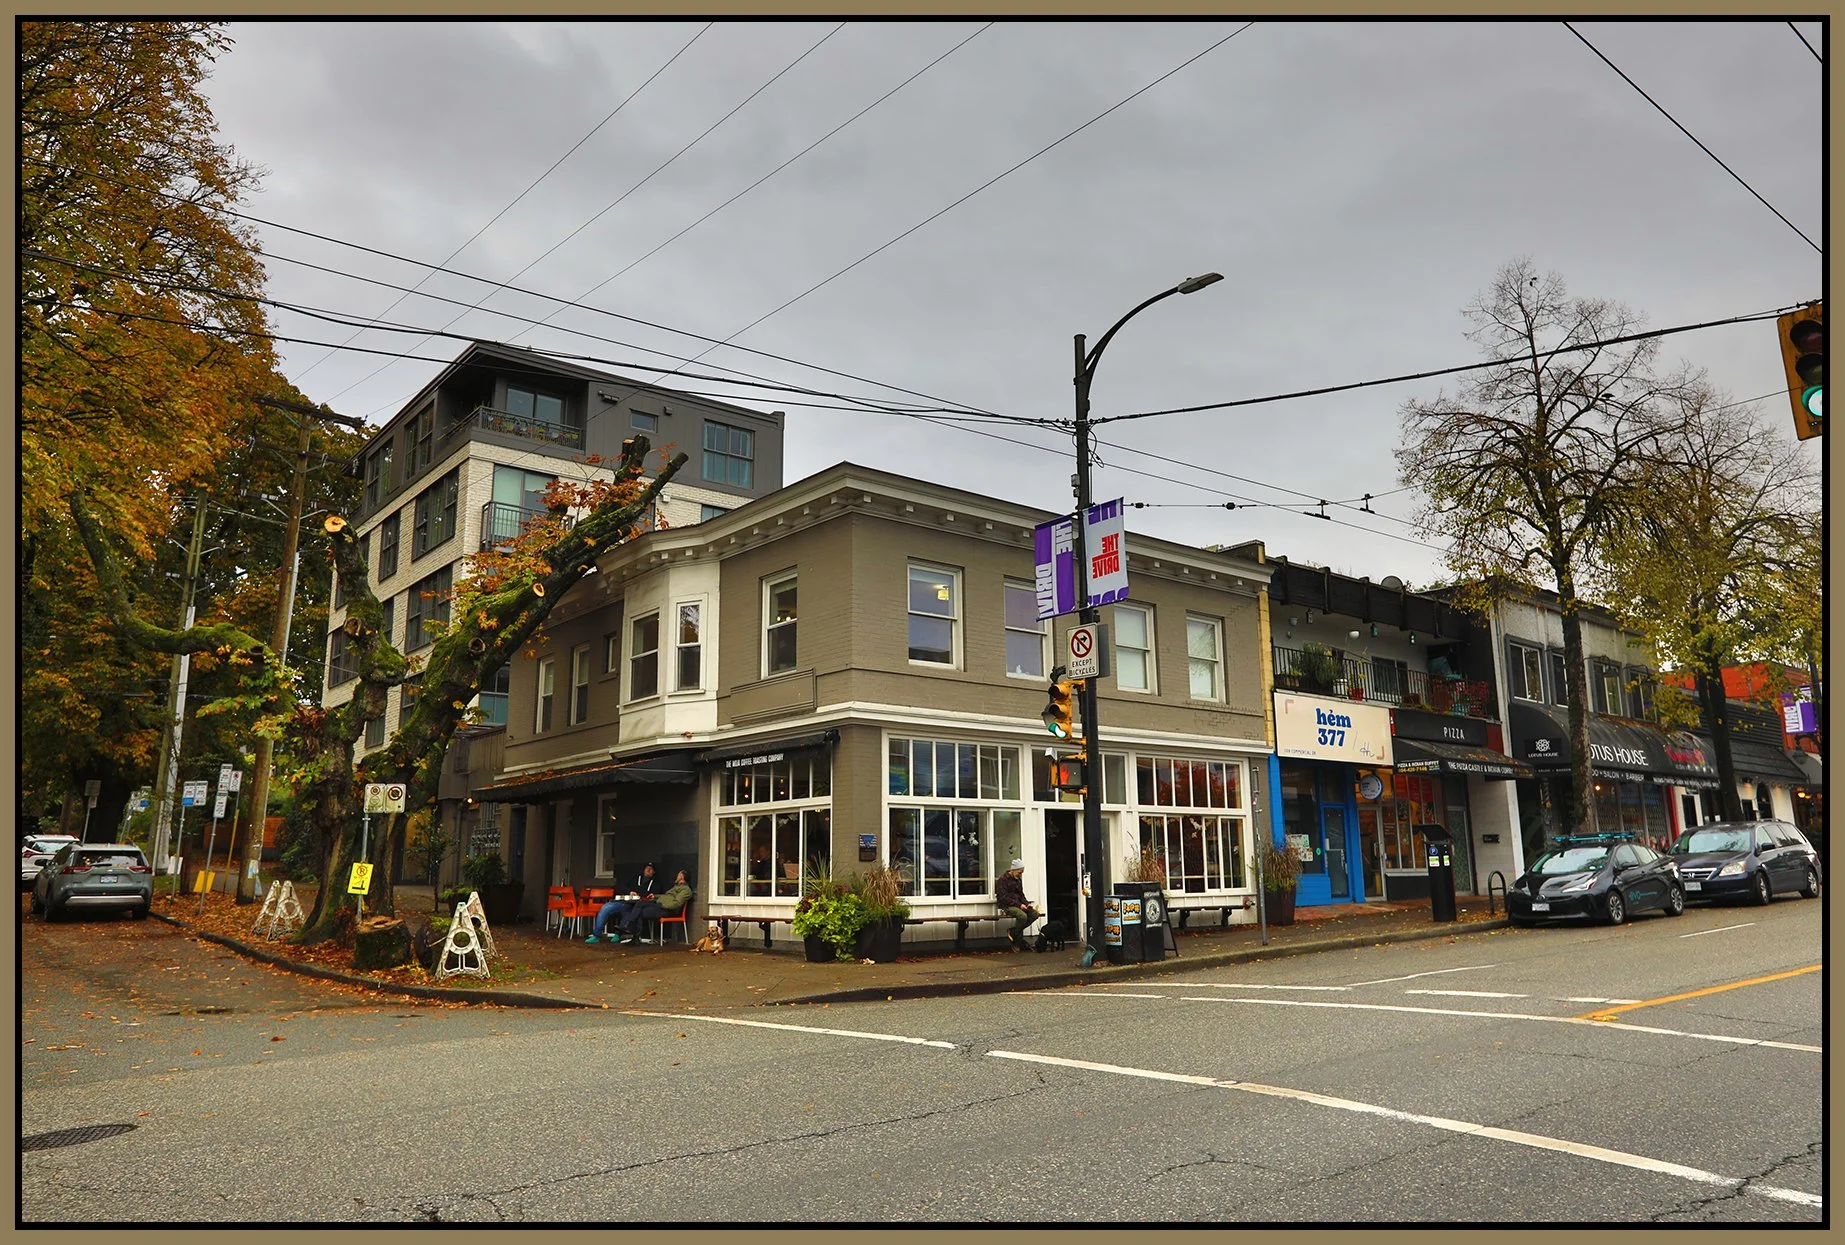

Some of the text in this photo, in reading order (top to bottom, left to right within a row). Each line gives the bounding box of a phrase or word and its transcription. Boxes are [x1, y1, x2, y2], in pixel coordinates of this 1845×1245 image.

[1056, 520, 1073, 555] THE
[1072, 659, 1092, 667] EXCEPT
[1069, 666, 1095, 676] BICYCLES
[1317, 728, 1345, 747] 377
[1443, 727, 1465, 739] PIZZA
[1614, 746, 1649, 766] HOUSE
[1604, 769, 1620, 779] SALON
[1626, 772, 1645, 781] BARBER
